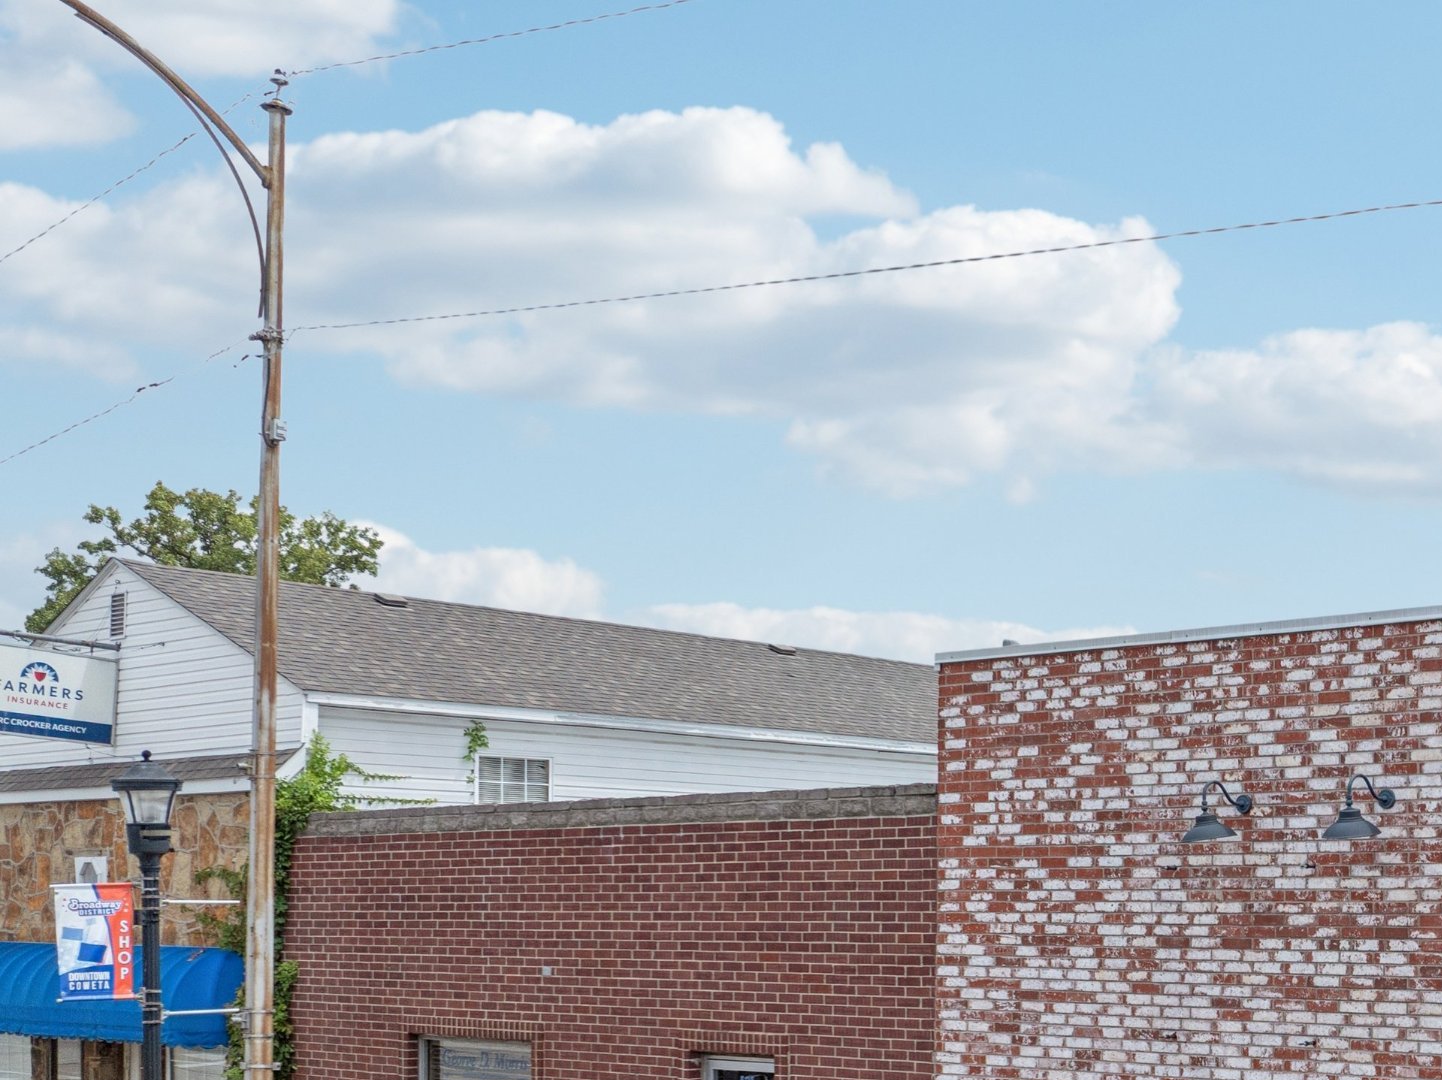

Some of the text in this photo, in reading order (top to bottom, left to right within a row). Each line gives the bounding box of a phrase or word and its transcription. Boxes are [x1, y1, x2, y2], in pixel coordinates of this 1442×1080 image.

[0, 680, 84, 701] ARMERS
[7, 695, 69, 710] INSURANCE
[10, 718, 51, 730] CROCKER
[52, 724, 87, 734] AGENCY
[68, 898, 123, 913] Broadway
[117, 920, 132, 980] SHOP
[68, 971, 111, 982] DOWNTOWN
[68, 981, 111, 990] COWETA
